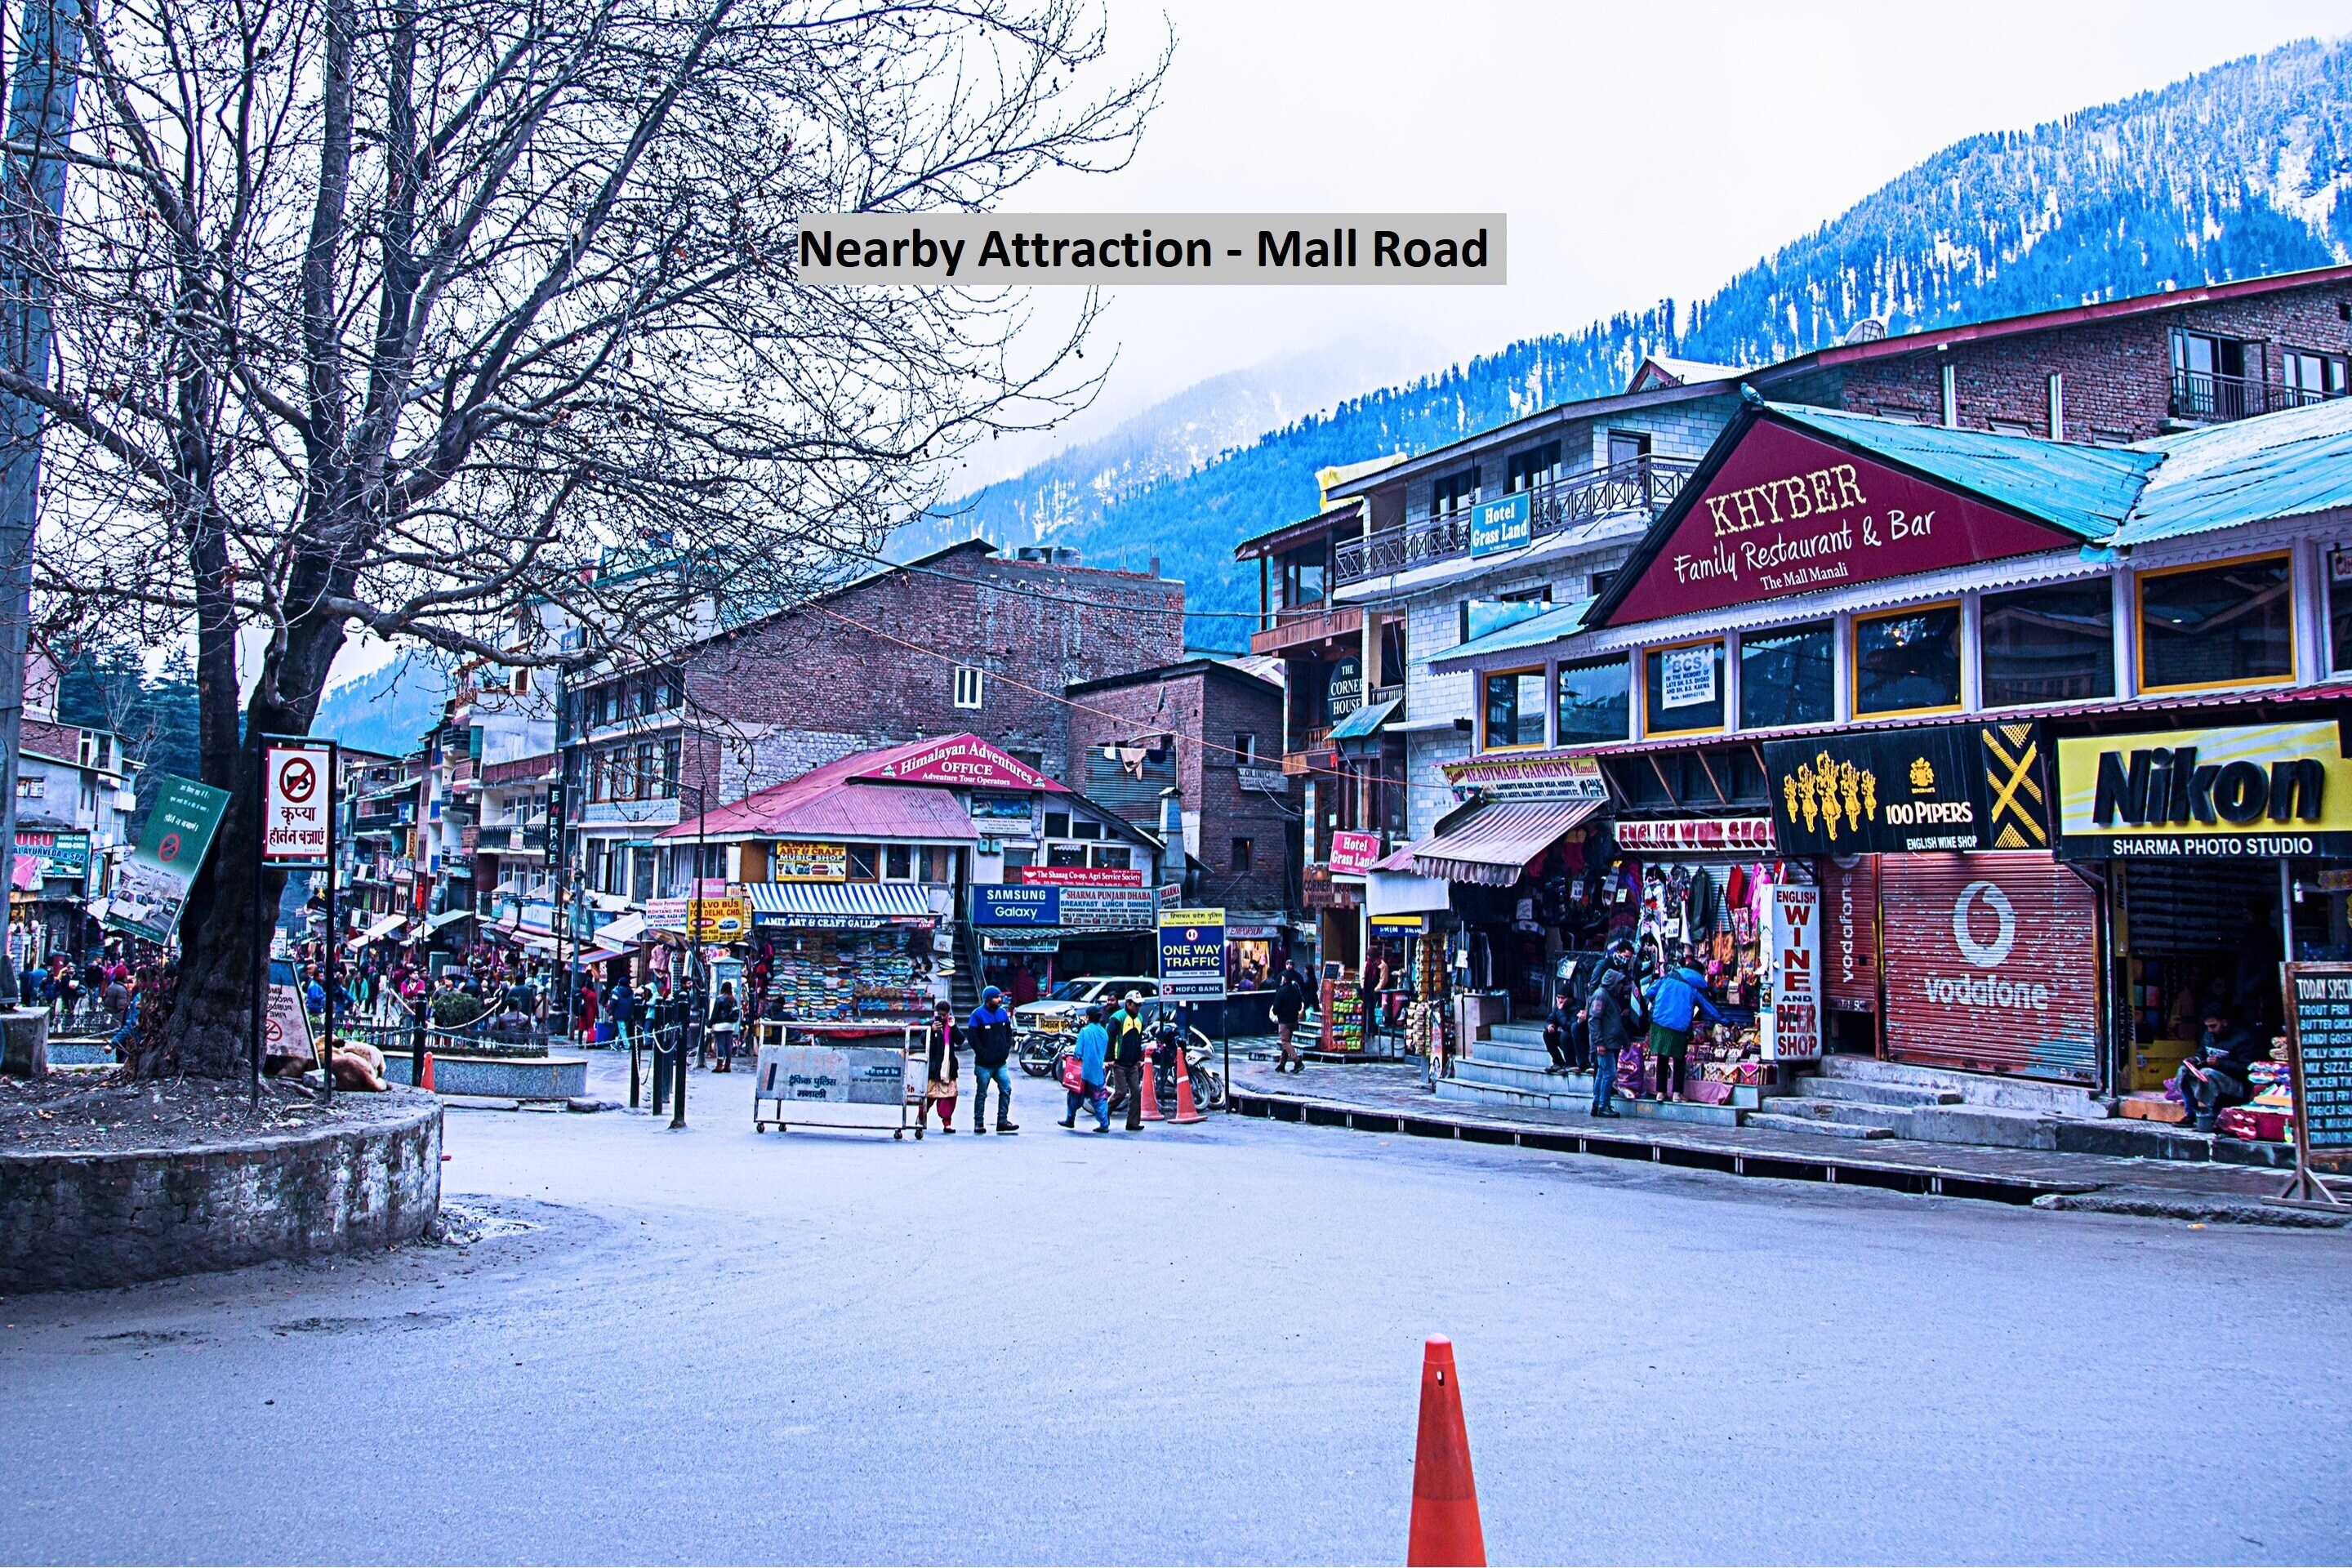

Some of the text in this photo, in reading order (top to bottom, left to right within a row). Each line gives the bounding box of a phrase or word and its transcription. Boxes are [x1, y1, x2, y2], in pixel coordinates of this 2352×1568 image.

[1705, 464, 1866, 537] KHYBER
[1485, 501, 1515, 525] Hotel
[1472, 518, 1527, 548] Grass Land
[1673, 510, 1936, 584] Family Restaurant & Bar
[1761, 562, 1849, 591] The Mall Manali
[1342, 665, 1353, 675] THE
[1672, 656, 1702, 674] BCS
[1682, 670, 1701, 679] MEMORY
[1666, 680, 1677, 688] LATE
[1333, 698, 1361, 715] HOUSE
[900, 741, 1032, 785] Himalayan Adventures
[941, 761, 993, 775] OFFICE
[1464, 760, 1598, 782] READYMADE GARMENTS Manali
[921, 772, 1010, 786] Adventure Tour Operators
[2092, 746, 2325, 825] Nikon
[1886, 801, 1973, 824] 100 PIPERS
[549, 791, 560, 864] EMERGE
[15, 833, 55, 847] URU
[1343, 837, 1367, 852] Hotel
[1905, 835, 1978, 850] ENGLISH WINE SHOP
[2113, 837, 2314, 855] SHARMA PHOTO STUDIO
[69, 853, 85, 862] SPA
[1331, 850, 1376, 869] Grass Land
[1049, 871, 1068, 880] Shanag
[1089, 872, 1101, 881] Agri
[987, 889, 1046, 900] SAMSUNG
[1067, 890, 1151, 901] SHARMA PUNJABI DHABA
[1160, 886, 1180, 898] SHARMA
[1776, 890, 1816, 904] ENGLISH
[996, 906, 1037, 920] Galaxy
[764, 917, 846, 928] AMIT ART & CRAFT
[1839, 873, 1854, 983] vodafone
[1163, 945, 1221, 956] ONE WAY
[1784, 905, 1811, 992] WINE
[1165, 956, 1220, 968] TRAFFIC
[1924, 973, 2048, 1010] vodafone
[2296, 979, 2326, 1000] TODAY
[2298, 1004, 2350, 1015] TROUT FISH
[1776, 1004, 1817, 1034] BEER
[2300, 1019, 2332, 1030] BUTTER
[1777, 1036, 1818, 1056] SHOP
